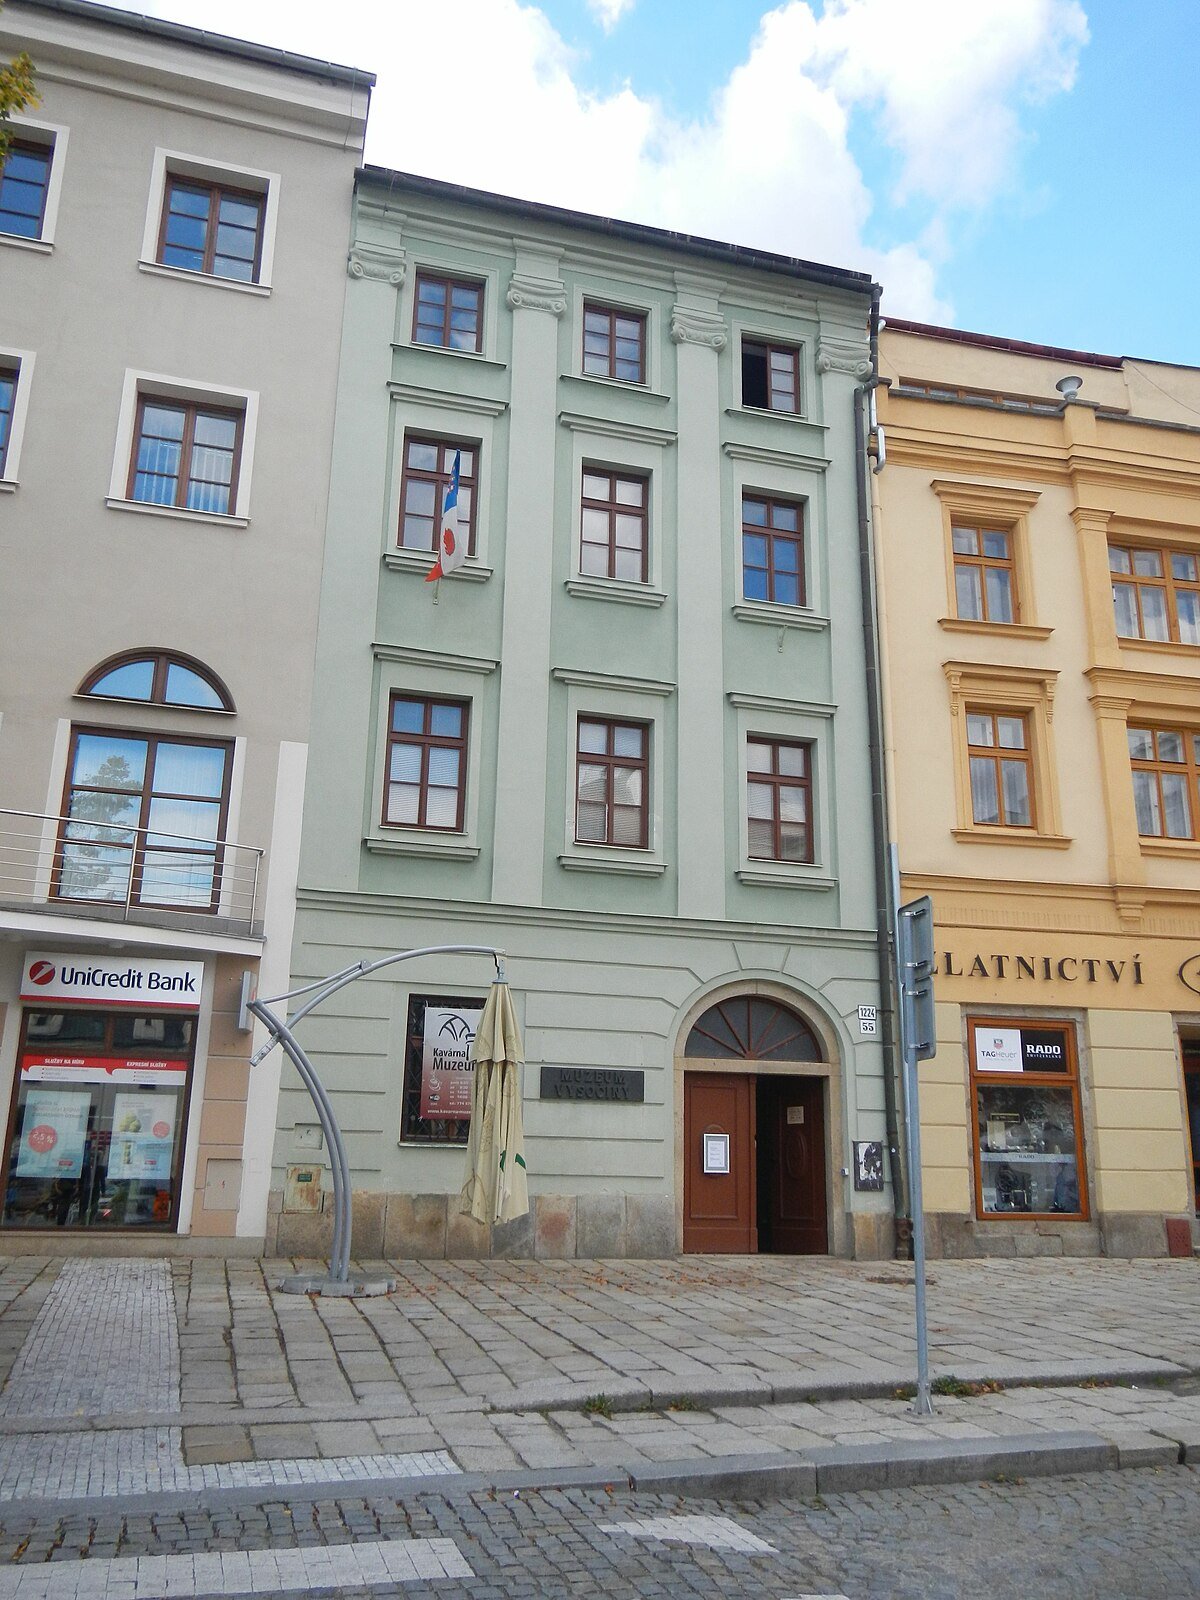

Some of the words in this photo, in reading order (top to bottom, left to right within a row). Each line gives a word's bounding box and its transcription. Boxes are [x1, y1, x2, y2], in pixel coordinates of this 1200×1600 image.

[61, 967, 144, 989] UniCredit
[147, 972, 196, 993] Bank
[860, 1007, 875, 1018] 1224
[862, 1022, 874, 1032] 55
[433, 1047, 466, 1058] Kavárna
[1026, 1044, 1061, 1055] RADO
[559, 1068, 626, 1085] MUZEUM
[554, 1083, 630, 1100] VYSOČINY
